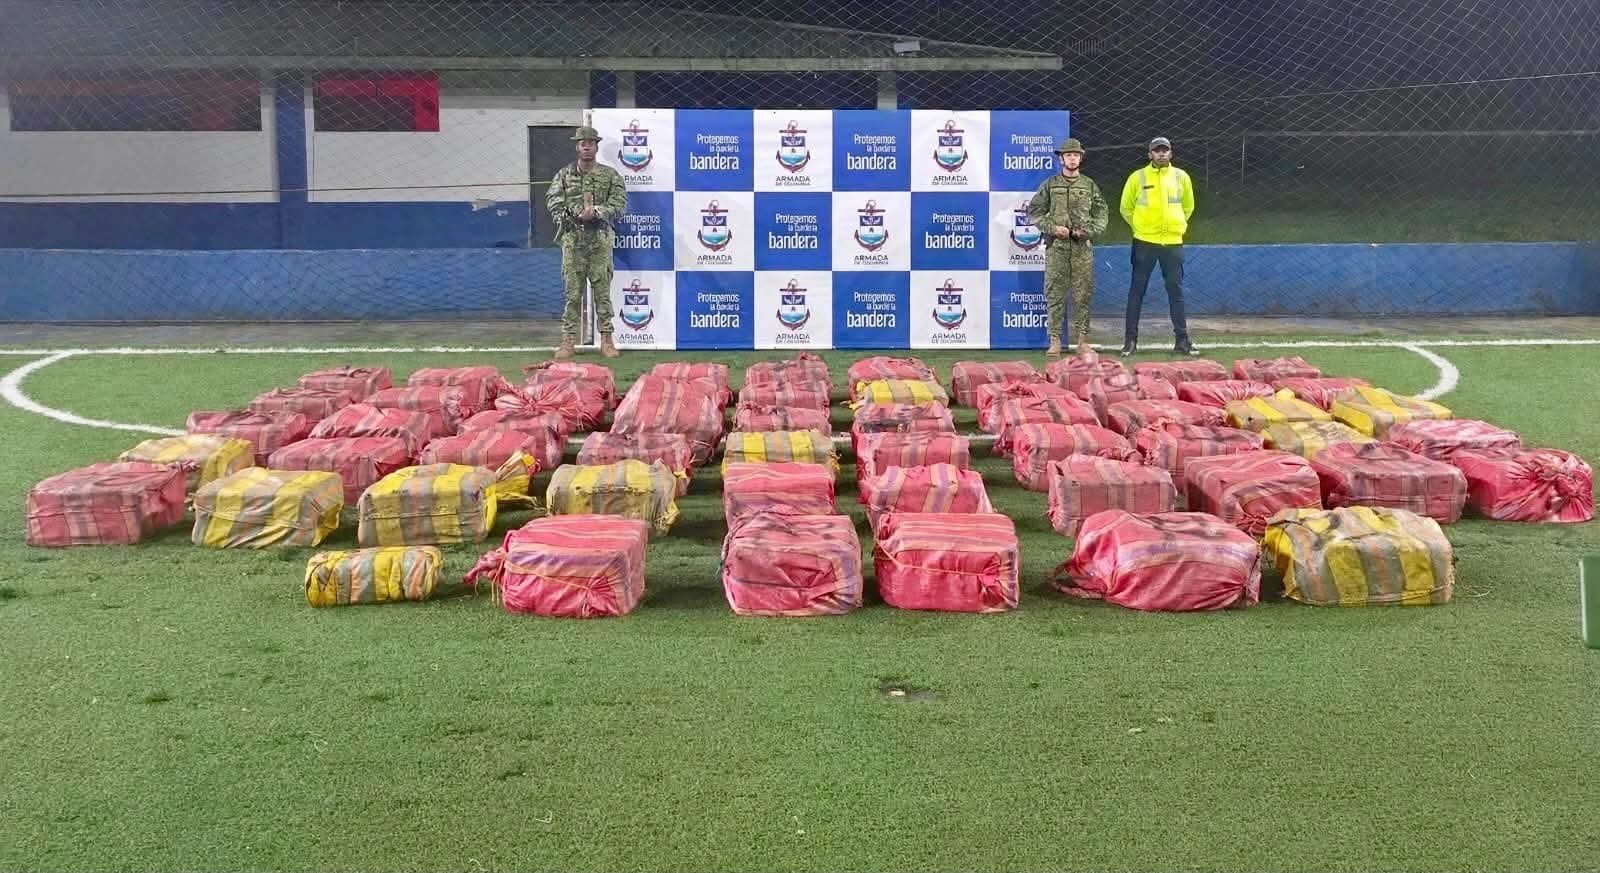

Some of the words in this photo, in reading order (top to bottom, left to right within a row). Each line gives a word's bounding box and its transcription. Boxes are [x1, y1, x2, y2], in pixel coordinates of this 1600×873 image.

[697, 134, 739, 146] Protegemos
[854, 134, 896, 146] Protegemos
[1011, 134, 1053, 146] Protegemos
[690, 152, 739, 170] bandera
[847, 152, 896, 170] bandera
[1004, 152, 1053, 170] bandera
[776, 214, 817, 225] Protegemos
[932, 214, 974, 225] Protegemos
[768, 232, 818, 248] bandera
[926, 232, 974, 248] bandera
[698, 293, 740, 304] Protegemos
[854, 293, 896, 304] Protegemos
[1010, 293, 1048, 304] Protegem
[690, 311, 740, 328] bandera
[847, 311, 896, 328] bandera
